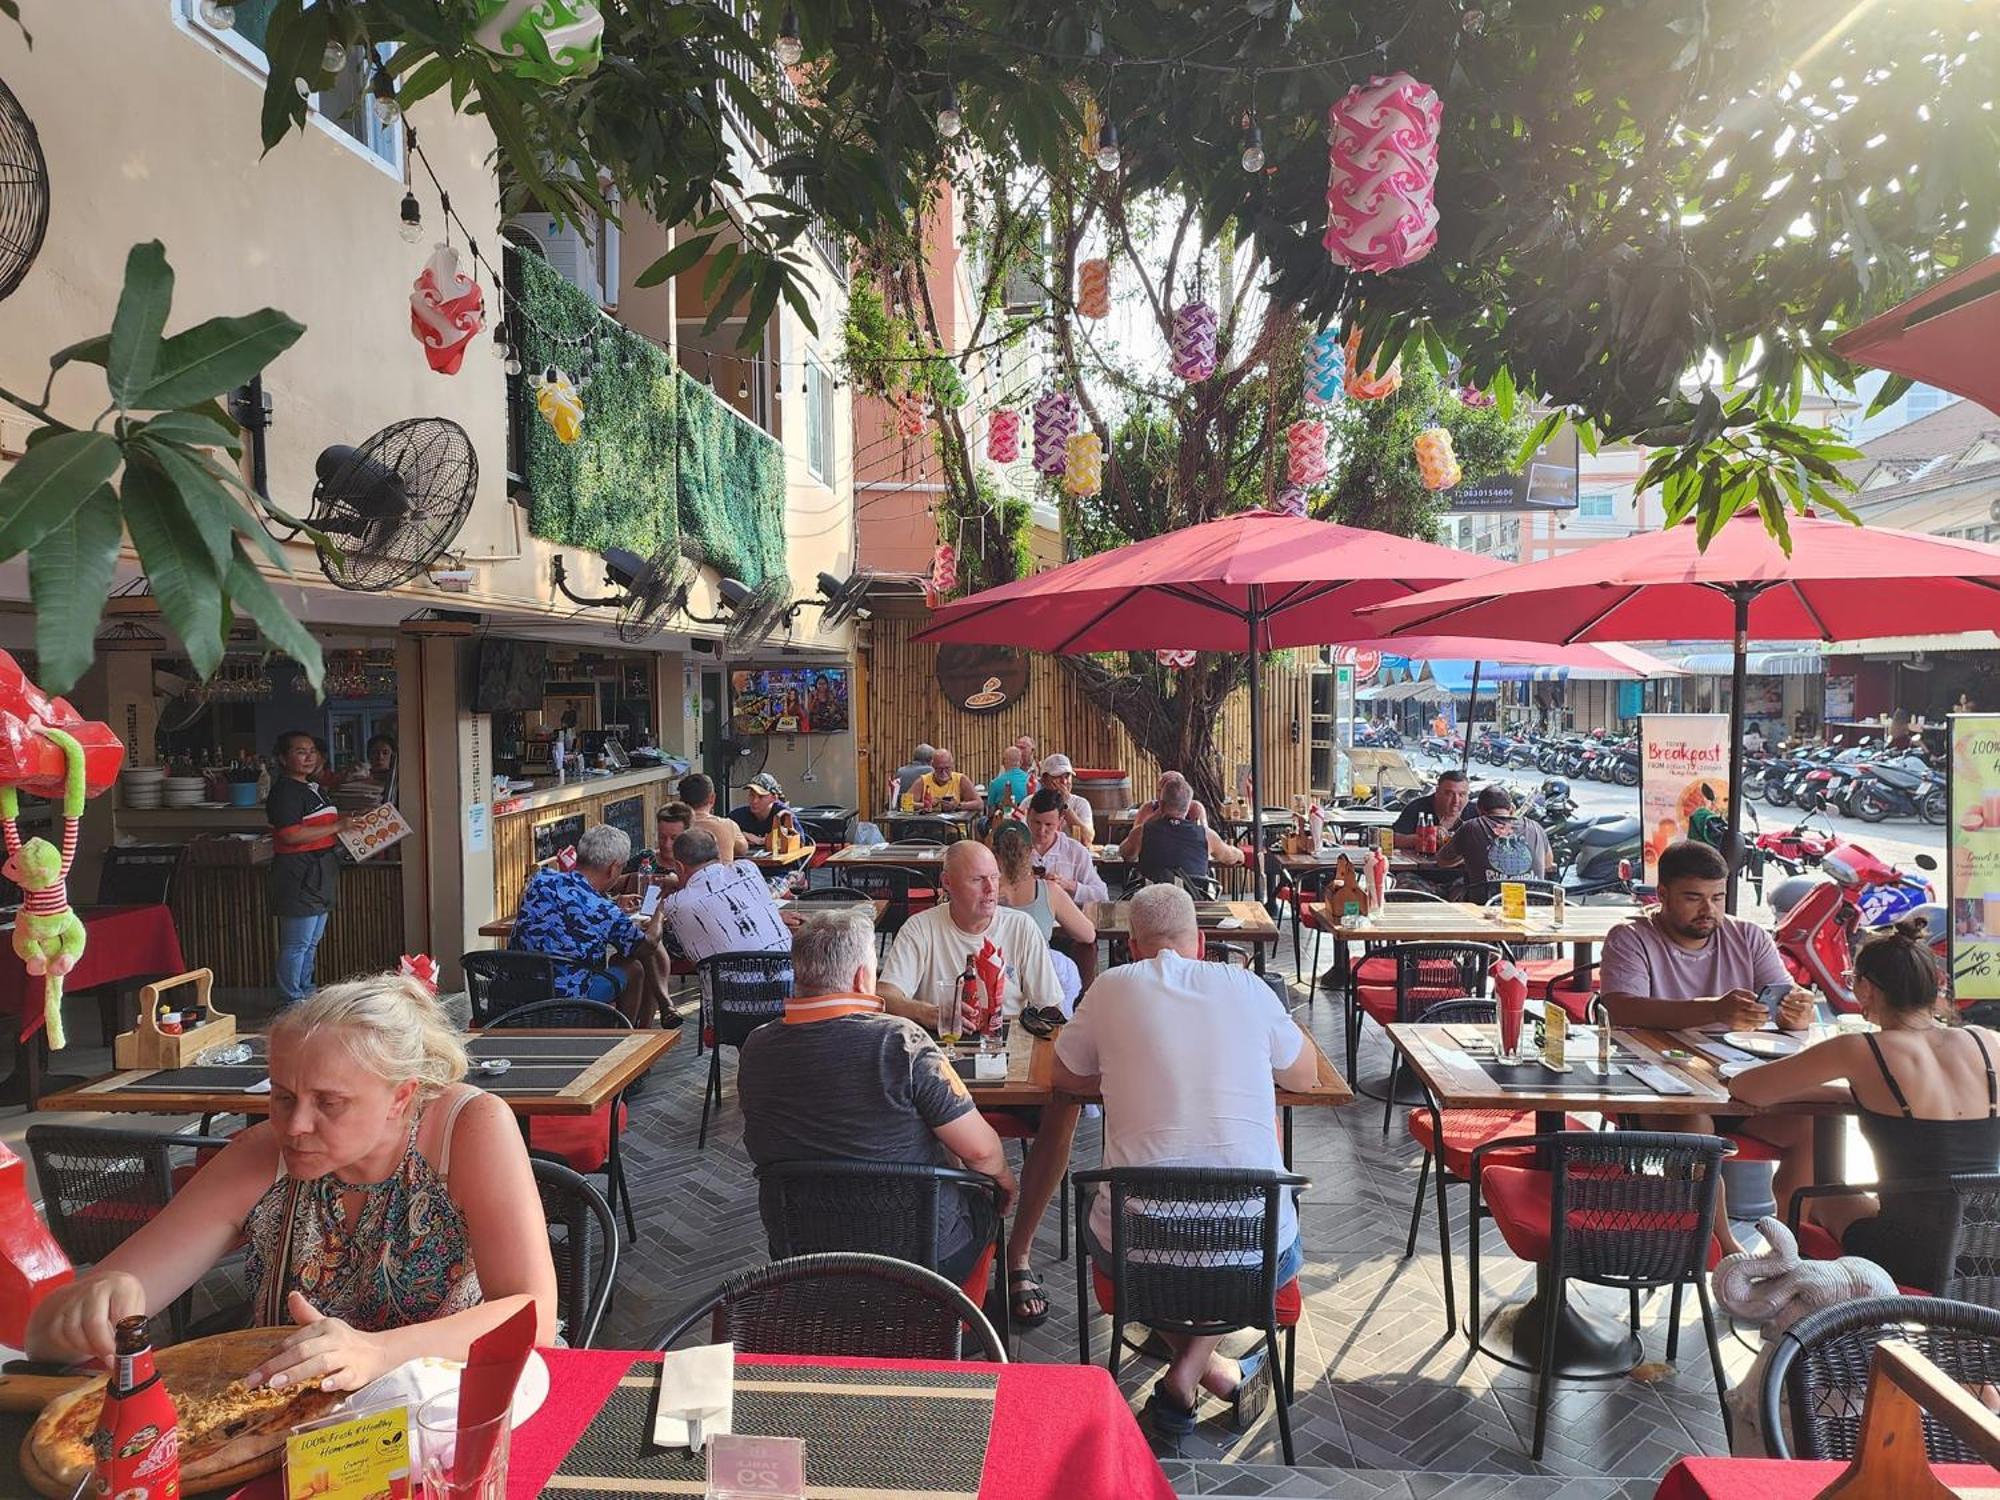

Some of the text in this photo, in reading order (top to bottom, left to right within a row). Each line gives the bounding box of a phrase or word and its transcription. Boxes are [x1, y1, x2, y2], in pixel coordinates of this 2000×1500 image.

[1649, 741, 1719, 769] Breakfast
[1971, 952, 1990, 961] NO
[1971, 966, 1991, 976] NO
